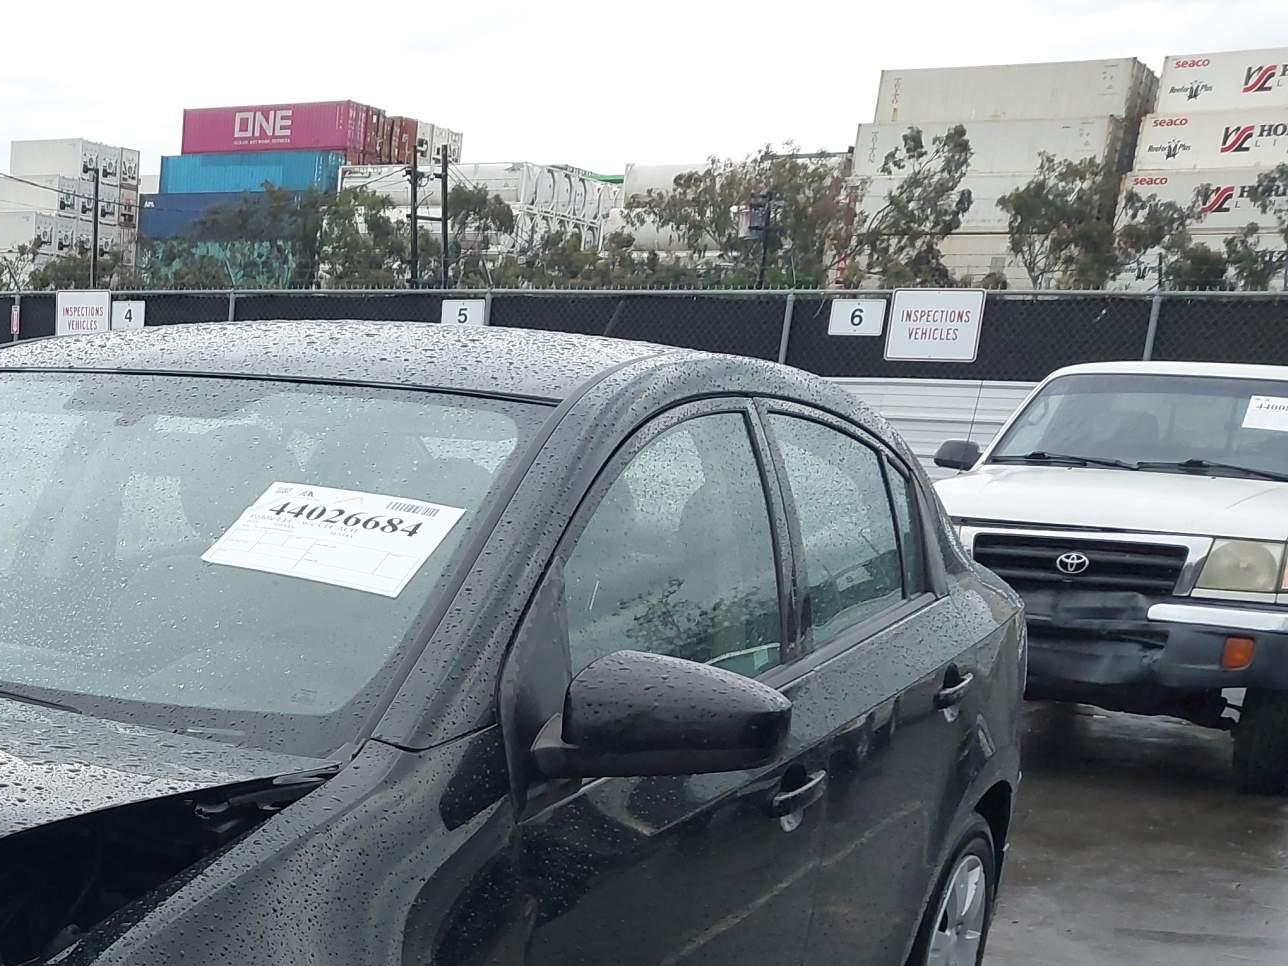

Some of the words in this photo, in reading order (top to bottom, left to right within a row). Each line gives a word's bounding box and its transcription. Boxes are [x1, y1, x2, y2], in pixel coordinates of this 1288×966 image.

[1175, 59, 1210, 69] seaco
[234, 110, 292, 137] ONE
[1152, 118, 1188, 128] seaco
[1132, 176, 1168, 185] seaco
[62, 306, 104, 317] INSPECTIONS
[124, 308, 133, 322] 4
[457, 307, 468, 324] 5
[850, 308, 864, 326] 6
[900, 309, 972, 323] INSPECTIONS
[67, 319, 98, 331] VEHICLES
[907, 327, 959, 341] VEHICLES
[268, 501, 423, 537] 44026684
